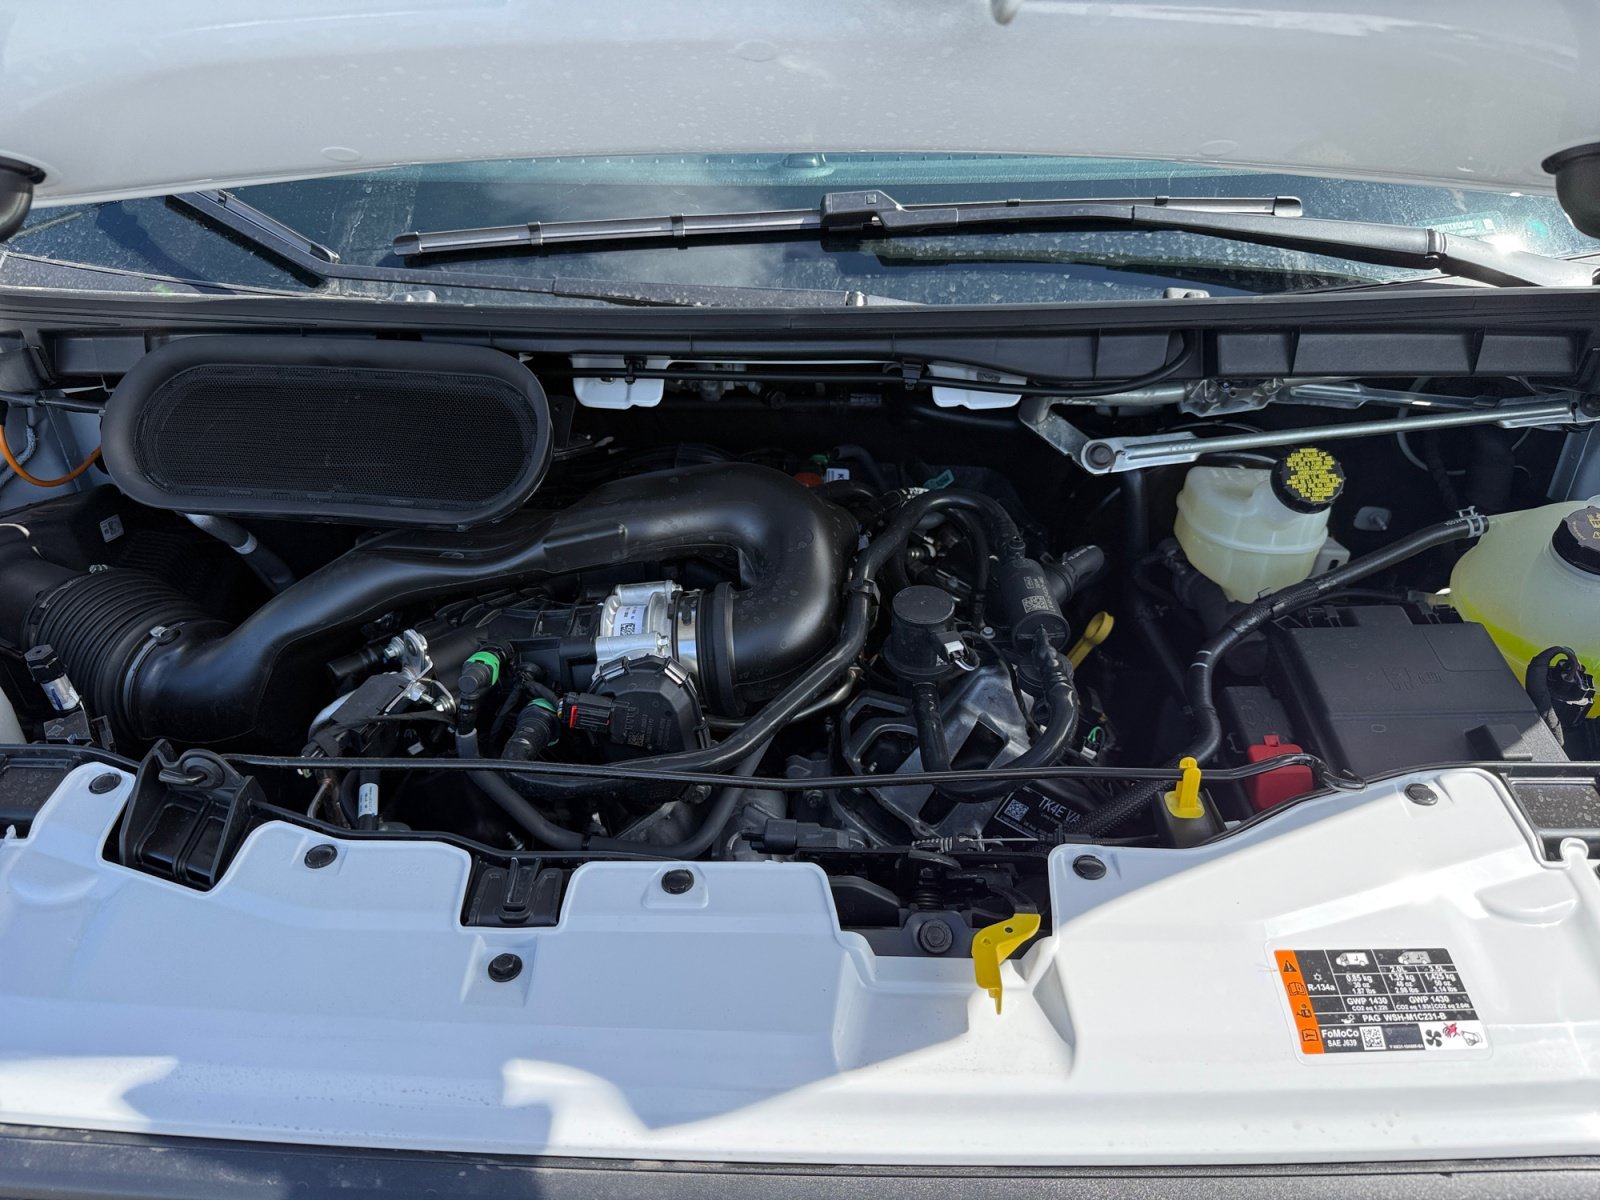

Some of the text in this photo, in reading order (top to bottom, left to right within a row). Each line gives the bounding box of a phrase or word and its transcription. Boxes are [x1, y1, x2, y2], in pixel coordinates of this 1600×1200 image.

[1362, 974, 1373, 983] kg
[1404, 974, 1415, 982] kg
[1445, 973, 1456, 982] kg
[1307, 983, 1336, 991] R-134a
[1346, 997, 1388, 1005] GWP 1430
[1408, 995, 1450, 1004] GWP 1430
[1362, 1012, 1447, 1022] PAG WSH-M1C231-B
[1321, 1029, 1359, 1038] FoMoCo
[1343, 1039, 1358, 1047] J639
